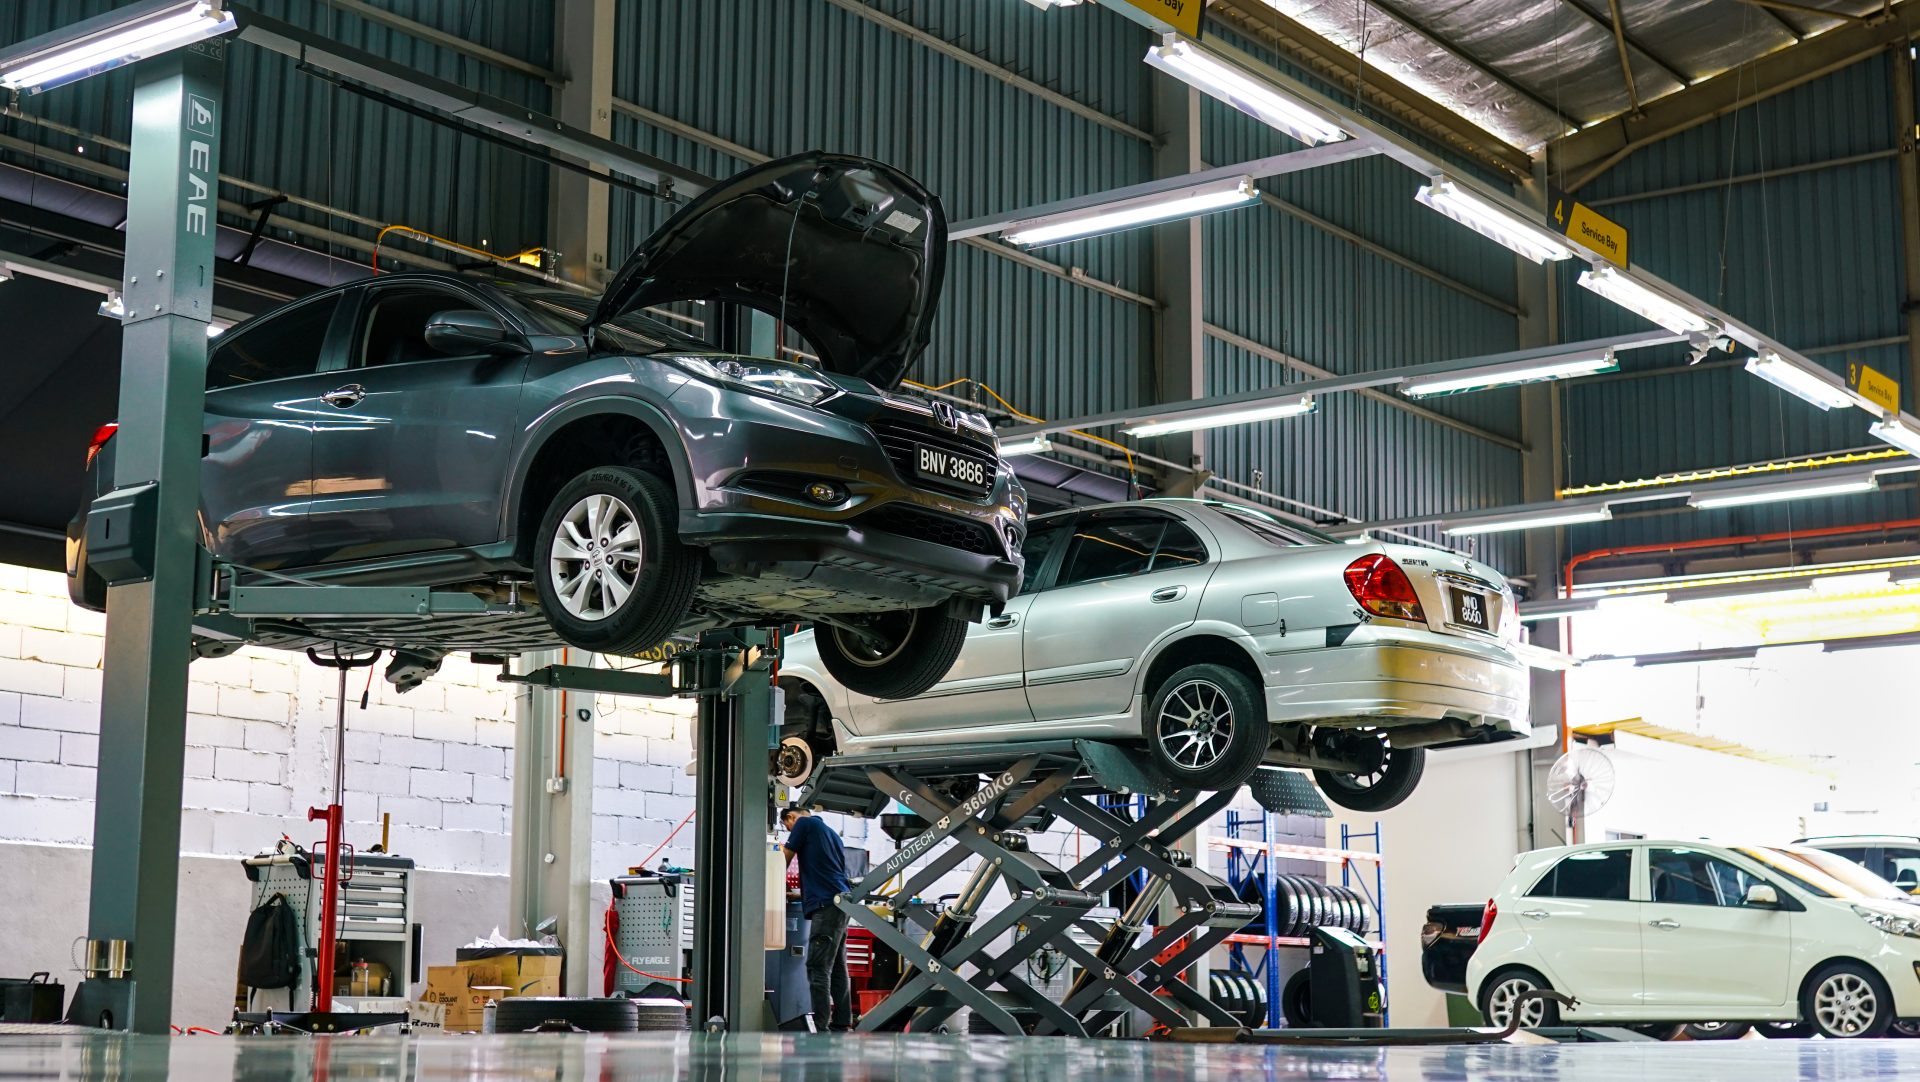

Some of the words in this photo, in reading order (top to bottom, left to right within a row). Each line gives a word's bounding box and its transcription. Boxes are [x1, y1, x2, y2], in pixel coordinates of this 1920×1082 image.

[186, 140, 210, 236] EAE
[1554, 199, 1564, 225] 4
[1581, 221, 1606, 245] Service
[1607, 234, 1618, 254] Bay
[1850, 363, 1857, 385] 3
[920, 448, 947, 475] BNV
[949, 456, 984, 484] 3866
[1461, 607, 1482, 625] 8660
[962, 772, 1015, 816] 3600KG
[885, 830, 936, 873] AUTOTECH
[631, 956, 671, 965] FLYEAGLE
